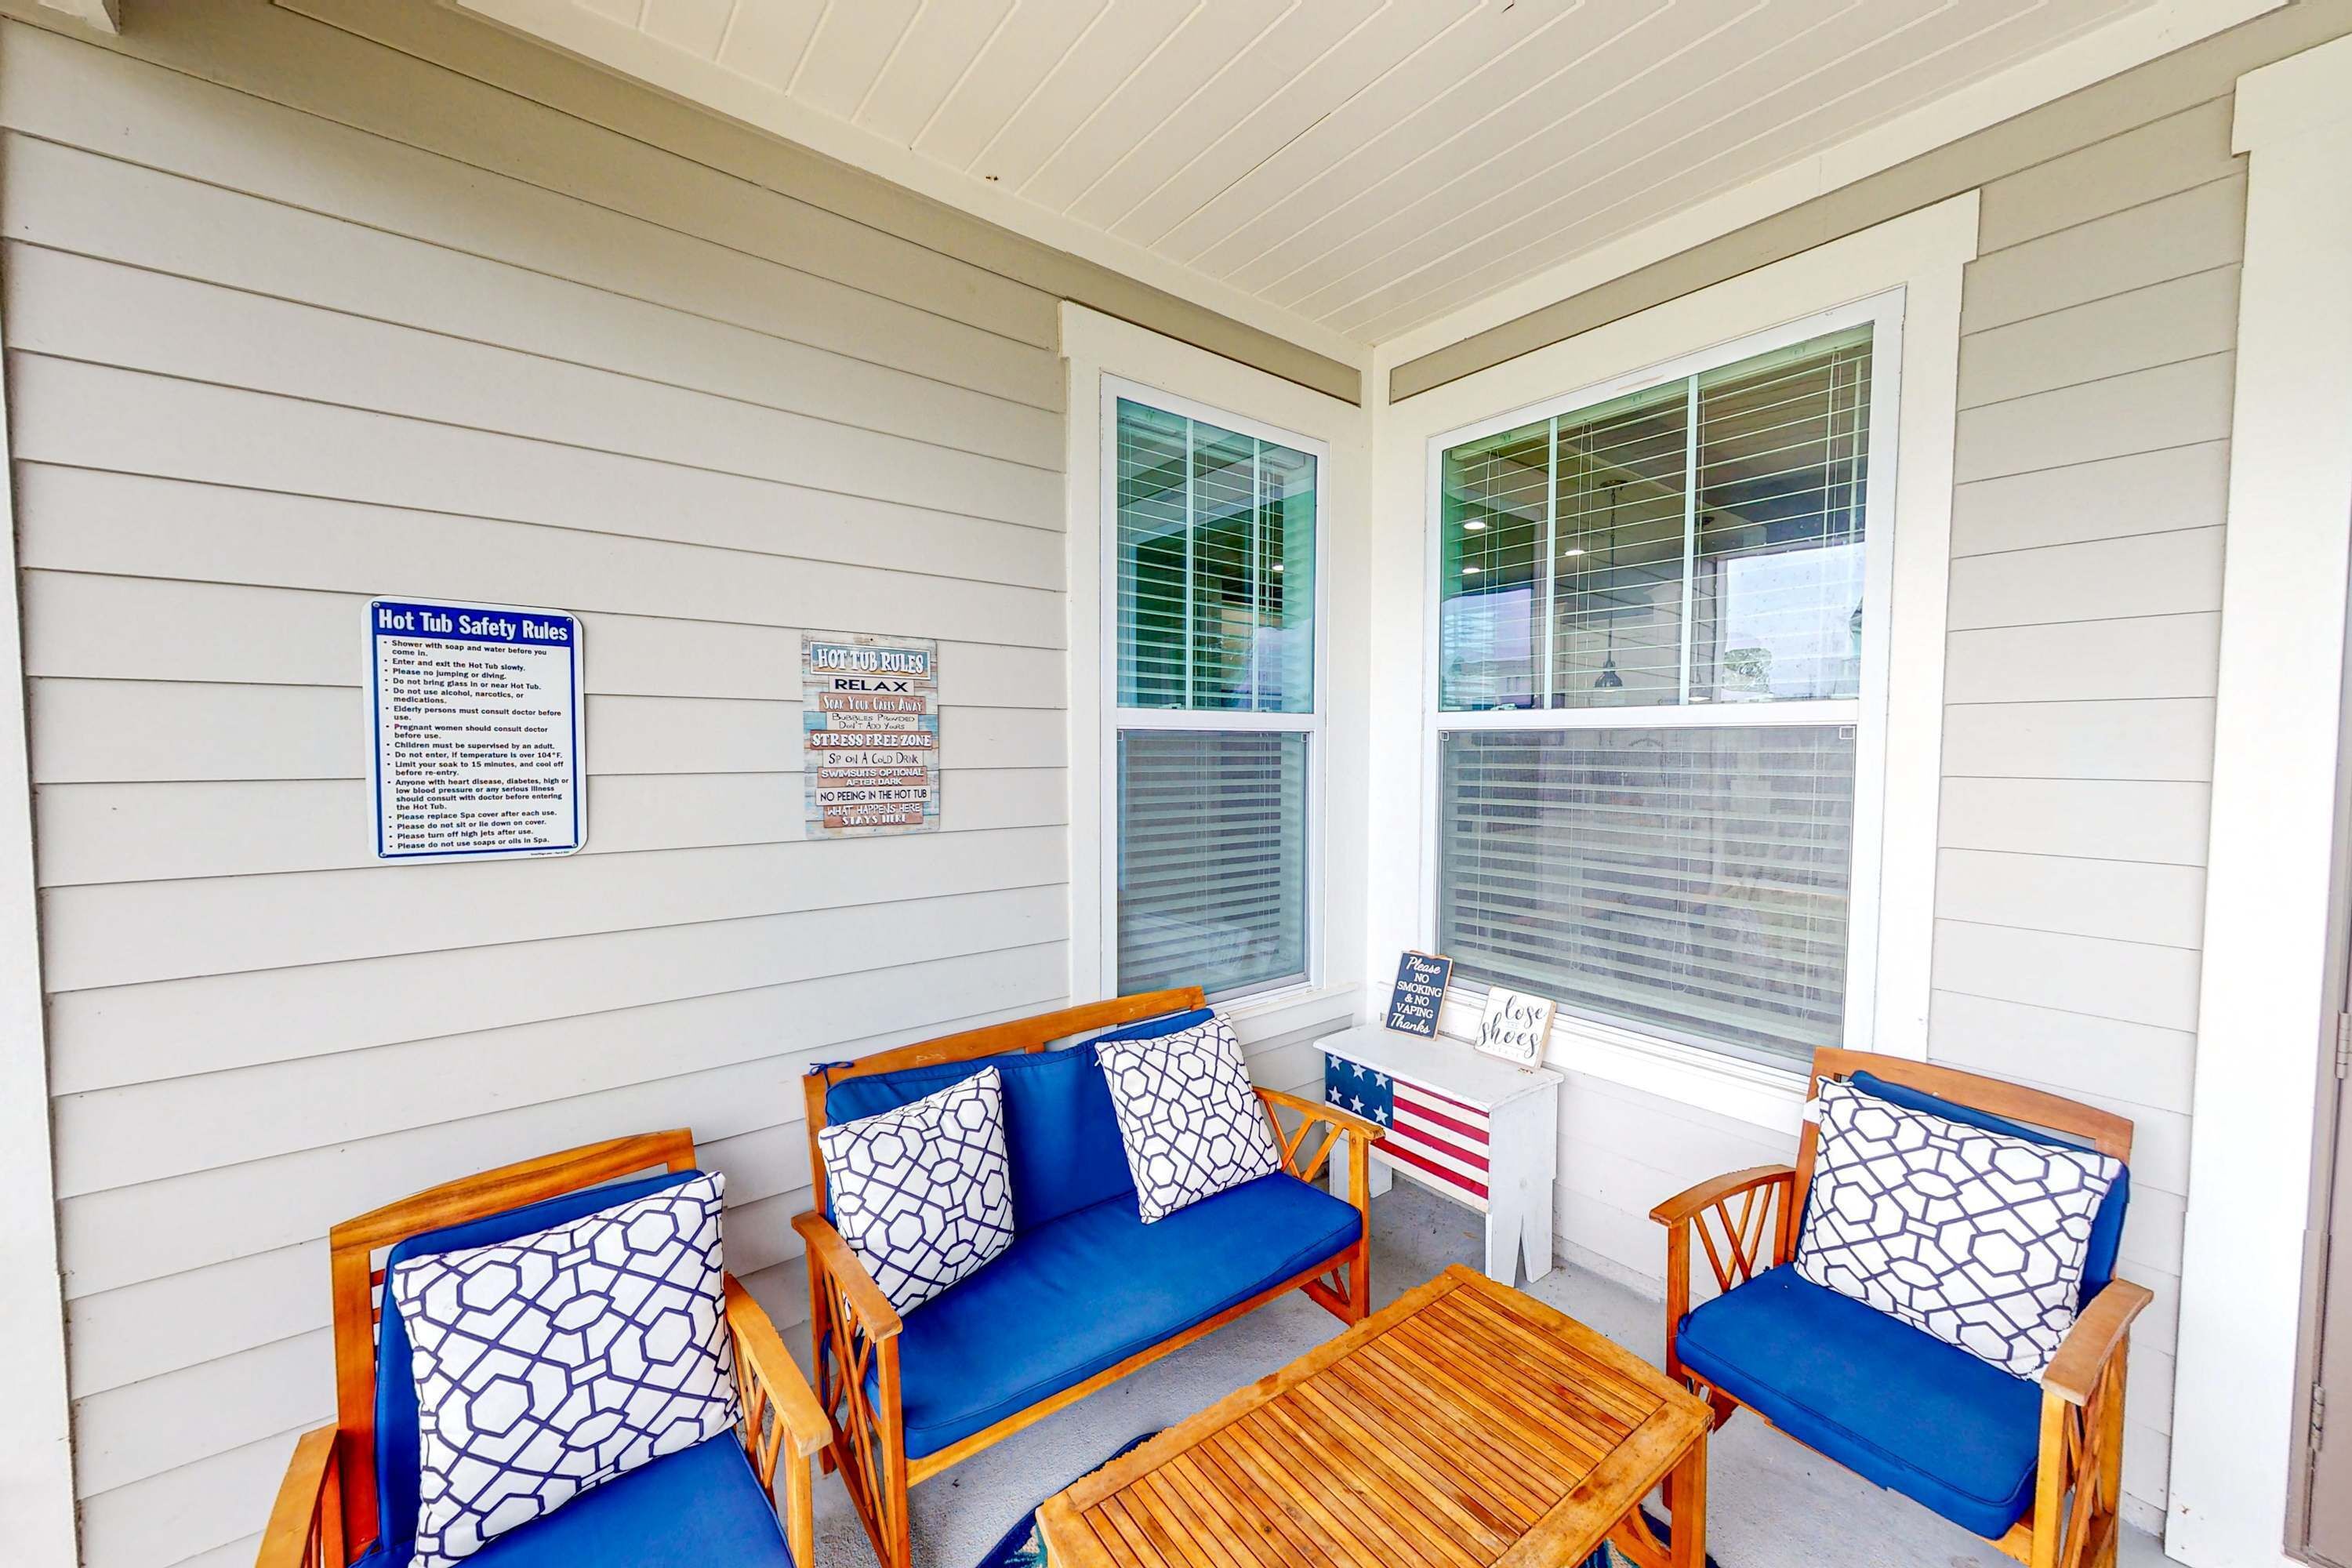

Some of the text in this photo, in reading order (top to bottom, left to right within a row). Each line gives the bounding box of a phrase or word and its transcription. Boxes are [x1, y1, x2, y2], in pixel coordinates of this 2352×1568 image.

[378, 608, 568, 641] Hot Tub Safety Rules
[817, 648, 924, 674] HOT TUB RULES
[436, 670, 468, 678] jumping
[835, 678, 909, 692] RELAX
[812, 733, 931, 746] STRESS FREE ZONE
[862, 752, 868, 764] A
[821, 768, 924, 778] SWIMSUITS OPTIONAL
[846, 778, 876, 786] AFTER
[820, 789, 927, 801] NO PEEING IN THE HOT TUB
[827, 803, 920, 816] WHAT HAPPENS HERE
[882, 815, 906, 823] HERE
[1406, 956, 1441, 975] Please
[1414, 973, 1429, 983] NO
[1397, 981, 1443, 997] SMOKING
[1404, 993, 1429, 1007] & NO
[1396, 1002, 1434, 1019] VAPING
[1505, 995, 1548, 1029] lose
[1390, 1012, 1430, 1034] Thanks
[1476, 1011, 1541, 1059] shoes
